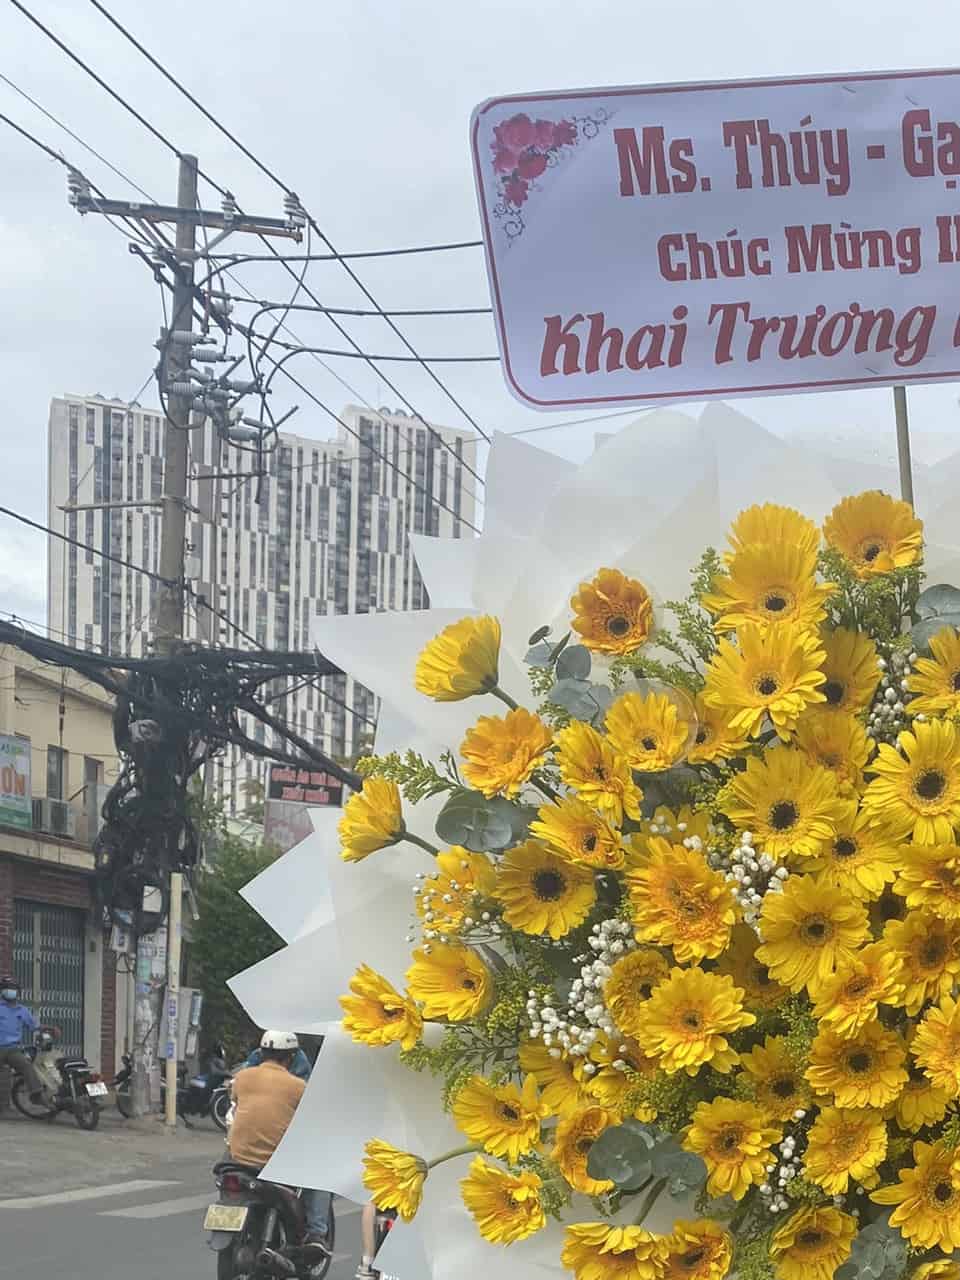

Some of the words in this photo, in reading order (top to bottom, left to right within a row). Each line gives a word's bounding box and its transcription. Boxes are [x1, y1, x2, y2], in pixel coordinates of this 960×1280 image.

[614, 126, 711, 198] Ms.
[723, 115, 851, 197] Thúy
[657, 229, 771, 282] Chúc
[784, 222, 921, 275] Mừng
[540, 305, 688, 377] Khai
[708, 301, 937, 366] Trương
